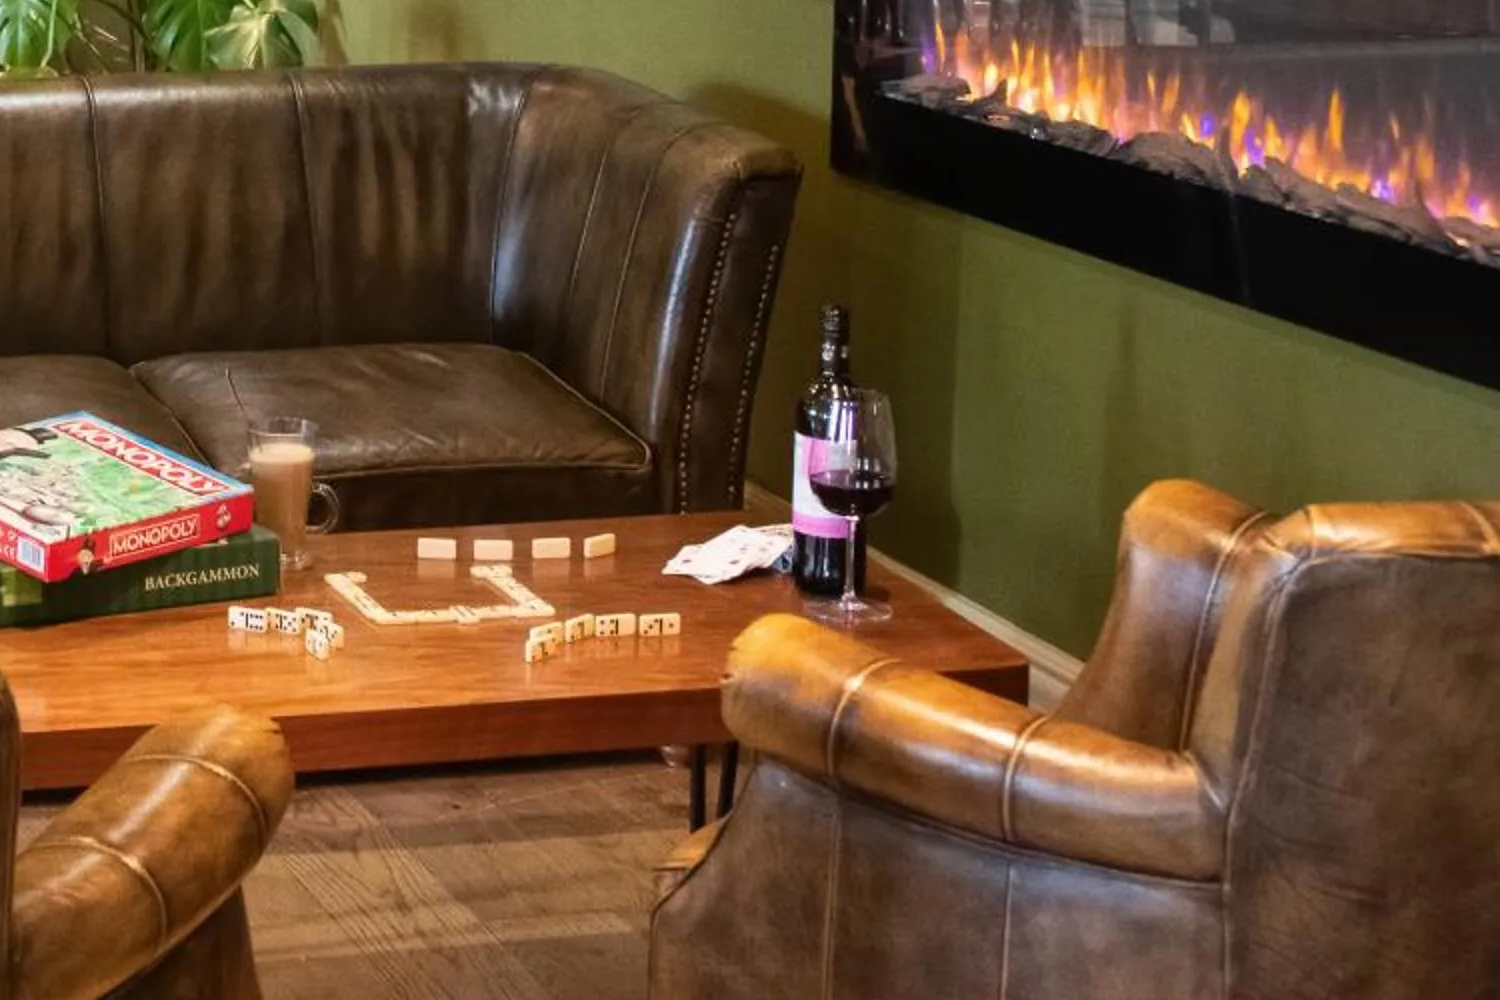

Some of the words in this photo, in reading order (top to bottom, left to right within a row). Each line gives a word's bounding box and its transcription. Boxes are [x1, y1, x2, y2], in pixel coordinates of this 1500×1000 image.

[58, 420, 218, 494] MONOPOLY
[112, 518, 197, 554] MONOPOLY
[145, 564, 260, 591] BACKGAMMON
